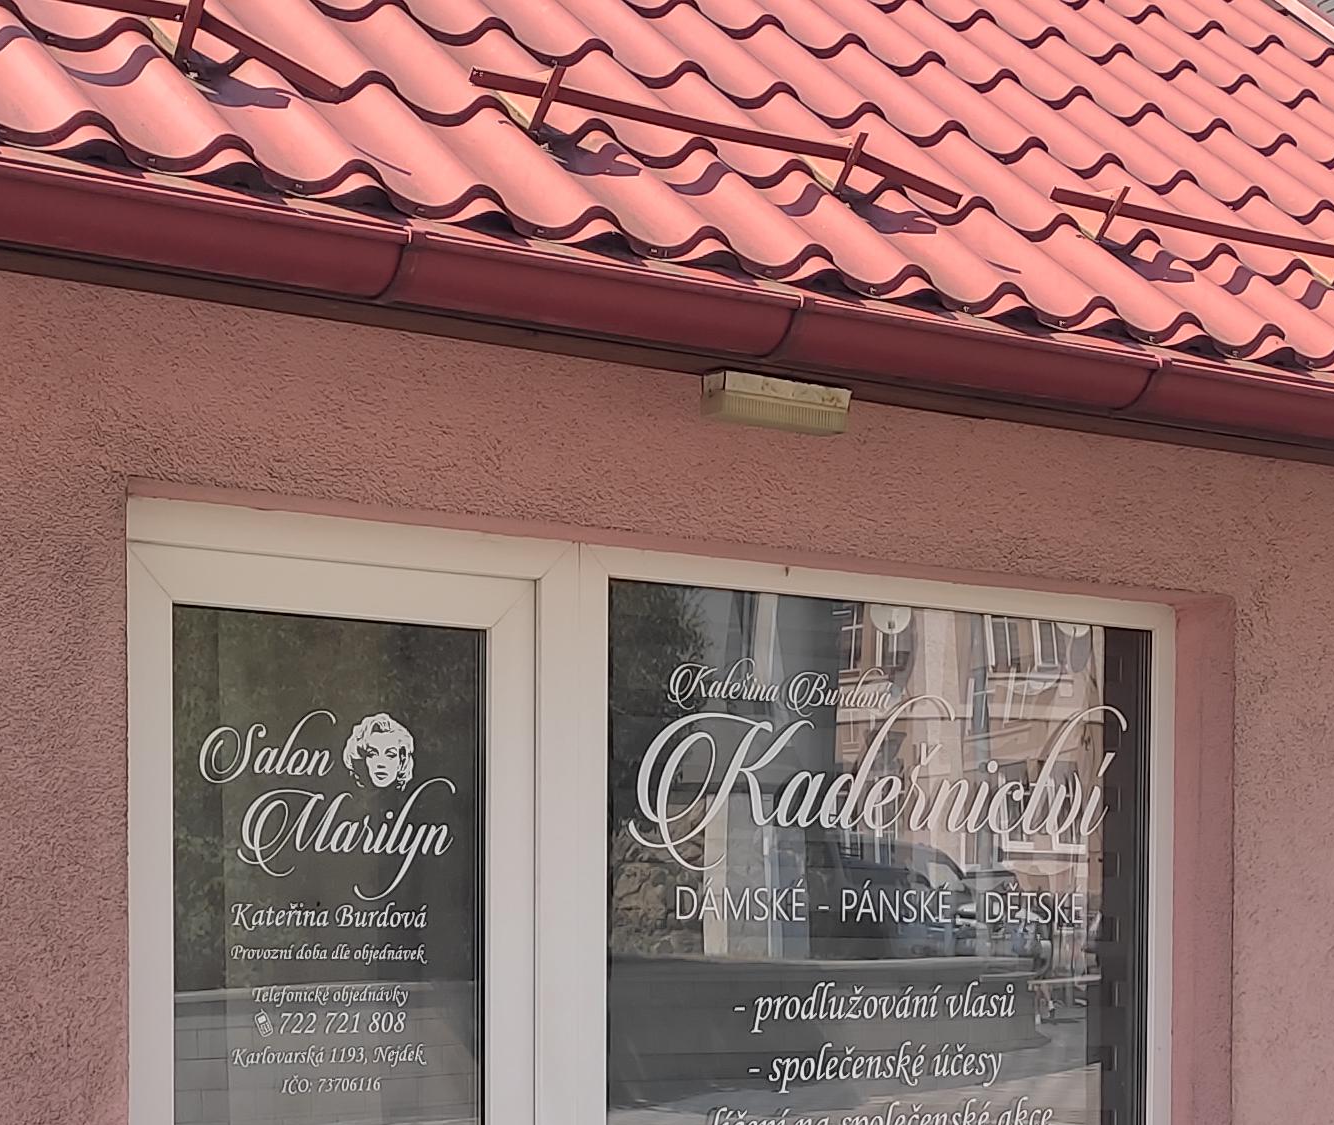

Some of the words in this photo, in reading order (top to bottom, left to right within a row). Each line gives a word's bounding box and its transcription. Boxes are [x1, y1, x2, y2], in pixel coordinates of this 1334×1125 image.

[667, 657, 780, 710] Kateřina
[786, 667, 893, 718] Burdová
[199, 710, 336, 784] Salon
[628, 694, 1128, 871] Kadeřnictví
[237, 777, 456, 900] Marilyn
[231, 903, 328, 930] Kateřina
[335, 902, 427, 928] Burdová
[675, 878, 806, 922] DÁMSKÉ
[840, 879, 952, 923] PÁNSKÉ
[985, 883, 1084, 924] DĚTSKÉ
[230, 944, 292, 961] Provozní
[295, 944, 327, 960] doba
[331, 944, 350, 960] dle
[353, 943, 428, 965] objednávek
[252, 986, 330, 1006] Telefonické
[333, 985, 409, 1006] objednávky
[751, 982, 942, 1033] prodlužování
[946, 981, 1016, 1018] vlasů
[278, 1012, 317, 1034] 722
[325, 1012, 360, 1034] 721
[368, 1012, 407, 1033] 808
[231, 1047, 325, 1067] Karlovarská
[330, 1048, 368, 1065] 1193,
[373, 1044, 428, 1067] Nejdek
[768, 1041, 926, 1094] společenské
[933, 1044, 1003, 1087] účesy
[281, 1075, 313, 1094] IČO:
[317, 1077, 382, 1093] 73706116
